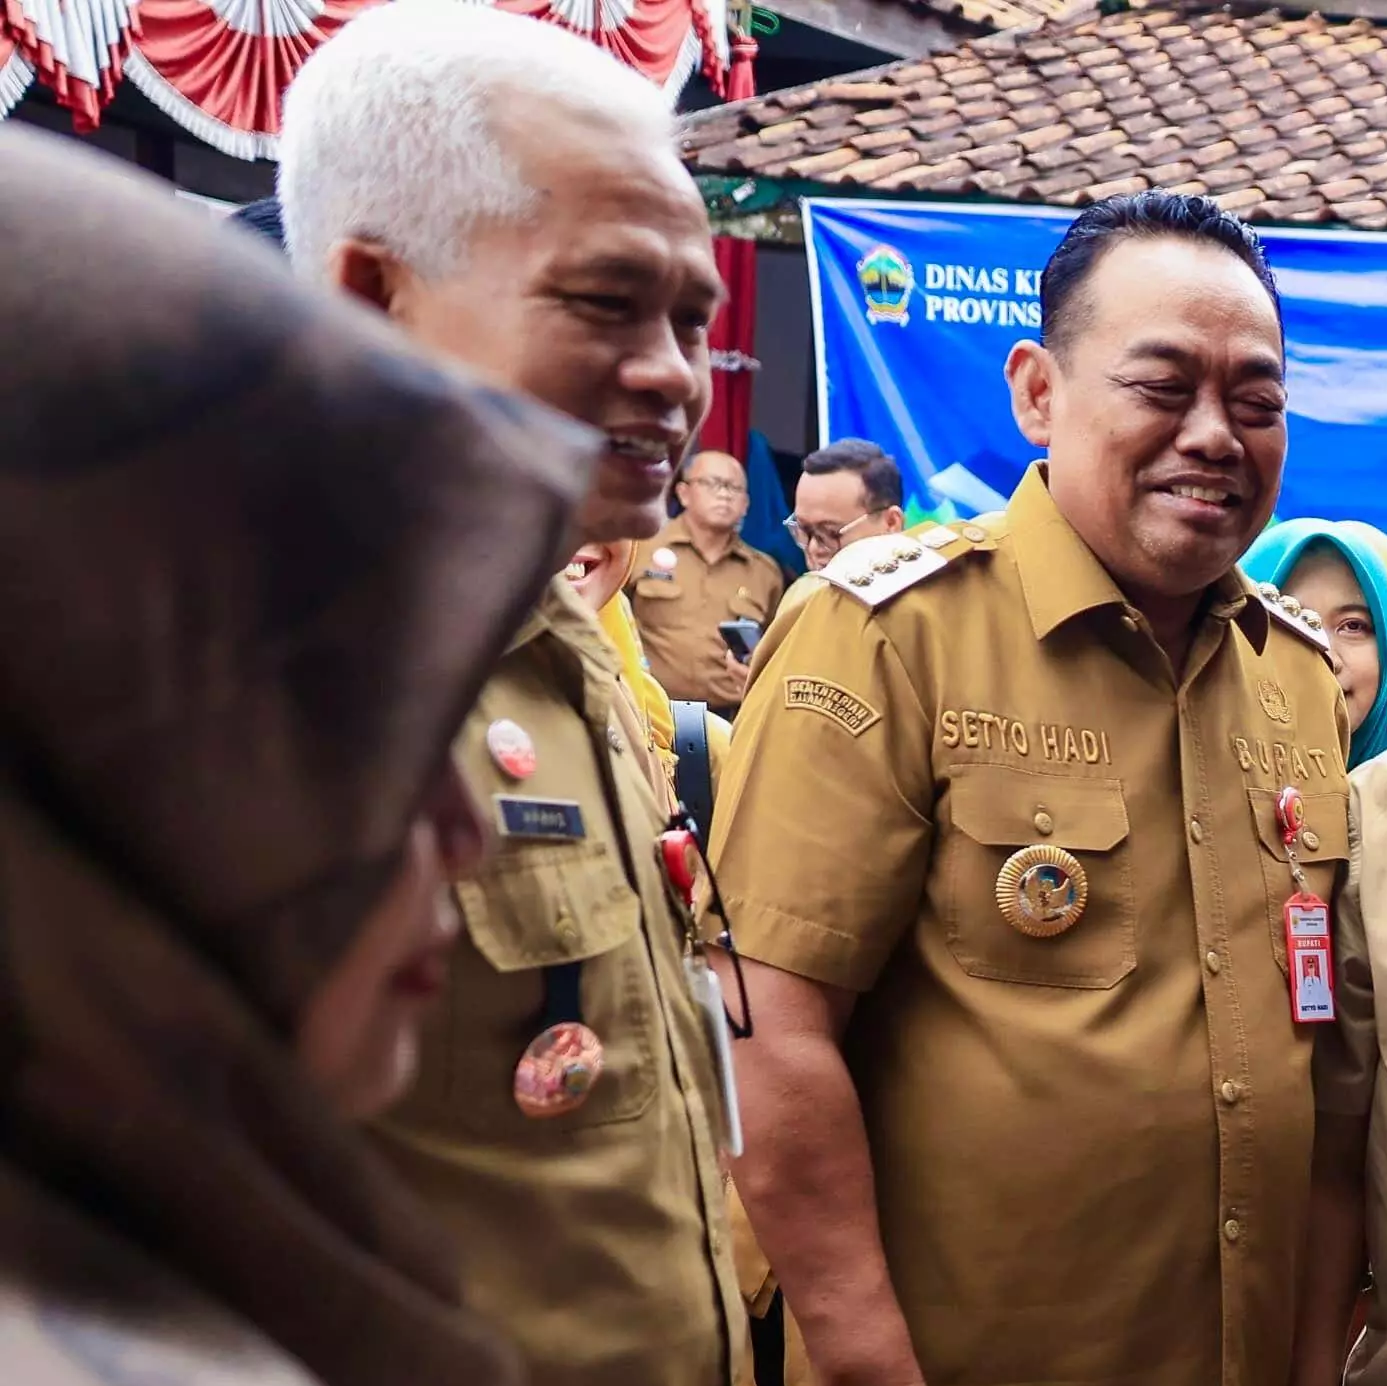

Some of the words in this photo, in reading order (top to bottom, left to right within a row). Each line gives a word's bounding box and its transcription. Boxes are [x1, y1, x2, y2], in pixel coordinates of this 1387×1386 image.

[925, 263, 1008, 294] DINAS
[789, 680, 869, 720] KEMENTERIAN
[941, 710, 1029, 757] SETYO
[1040, 721, 1113, 766] HADI
[1234, 737, 1346, 780] BUPATI
[1297, 939, 1321, 948] BUPATI
